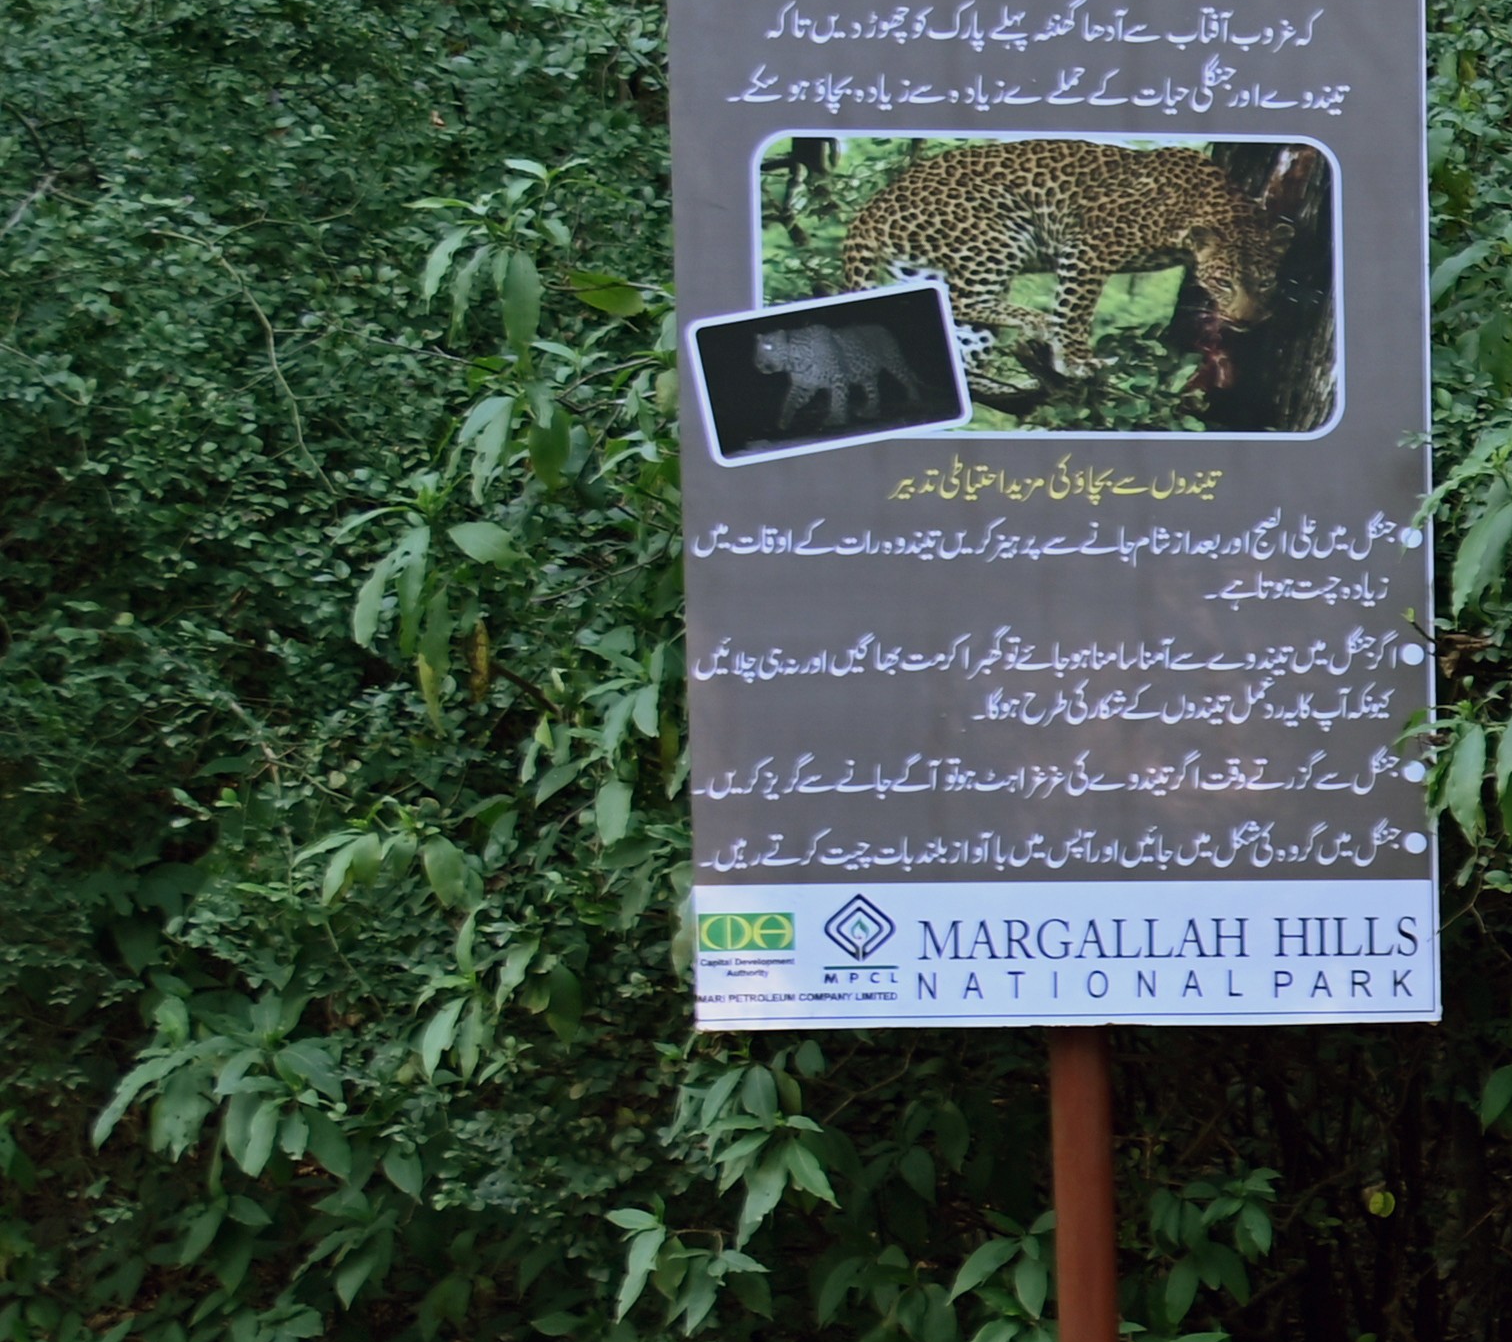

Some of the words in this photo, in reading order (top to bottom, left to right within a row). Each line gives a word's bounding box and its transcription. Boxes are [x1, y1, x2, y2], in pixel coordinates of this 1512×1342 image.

[917, 916, 1250, 962] MARGALLAH
[1272, 914, 1419, 959] HILLS
[700, 958, 732, 967] Capital
[735, 958, 795, 967] Development
[727, 969, 769, 978] Authority
[823, 971, 897, 985] MPCL
[917, 968, 1243, 1000] NATIONAL
[1273, 968, 1413, 999] PARK
[696, 995, 725, 1004] MARI
[729, 993, 795, 1003] PETROLEUM
[799, 992, 851, 1002] COMPANY
[855, 991, 898, 1001] LIMITED
